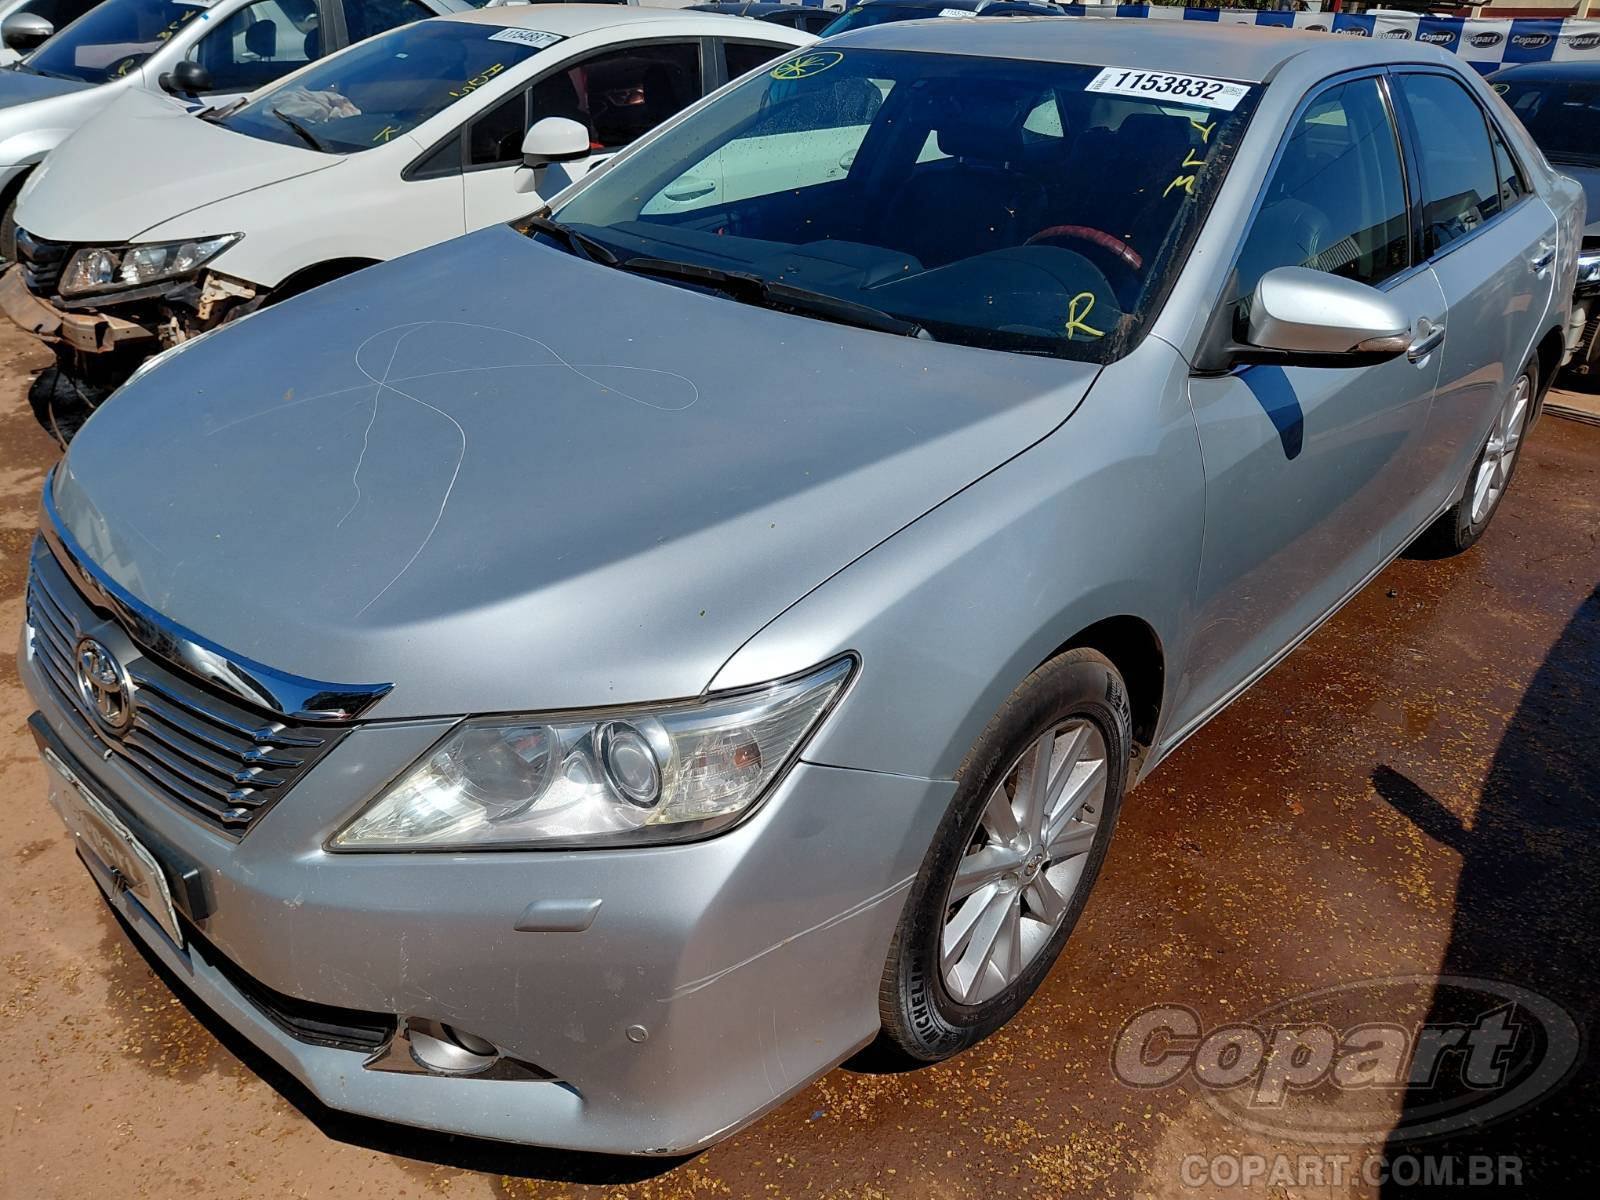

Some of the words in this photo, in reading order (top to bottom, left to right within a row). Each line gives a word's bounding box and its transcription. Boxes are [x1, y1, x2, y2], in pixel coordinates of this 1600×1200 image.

[1420, 32, 1452, 43] Copart
[1465, 33, 1498, 43] Copart
[1512, 35, 1547, 46] Copart
[1562, 36, 1600, 46] Copart
[1114, 71, 1224, 100] 1153832
[1065, 292, 1105, 341] R
[911, 957, 942, 1044] MICHELIN
